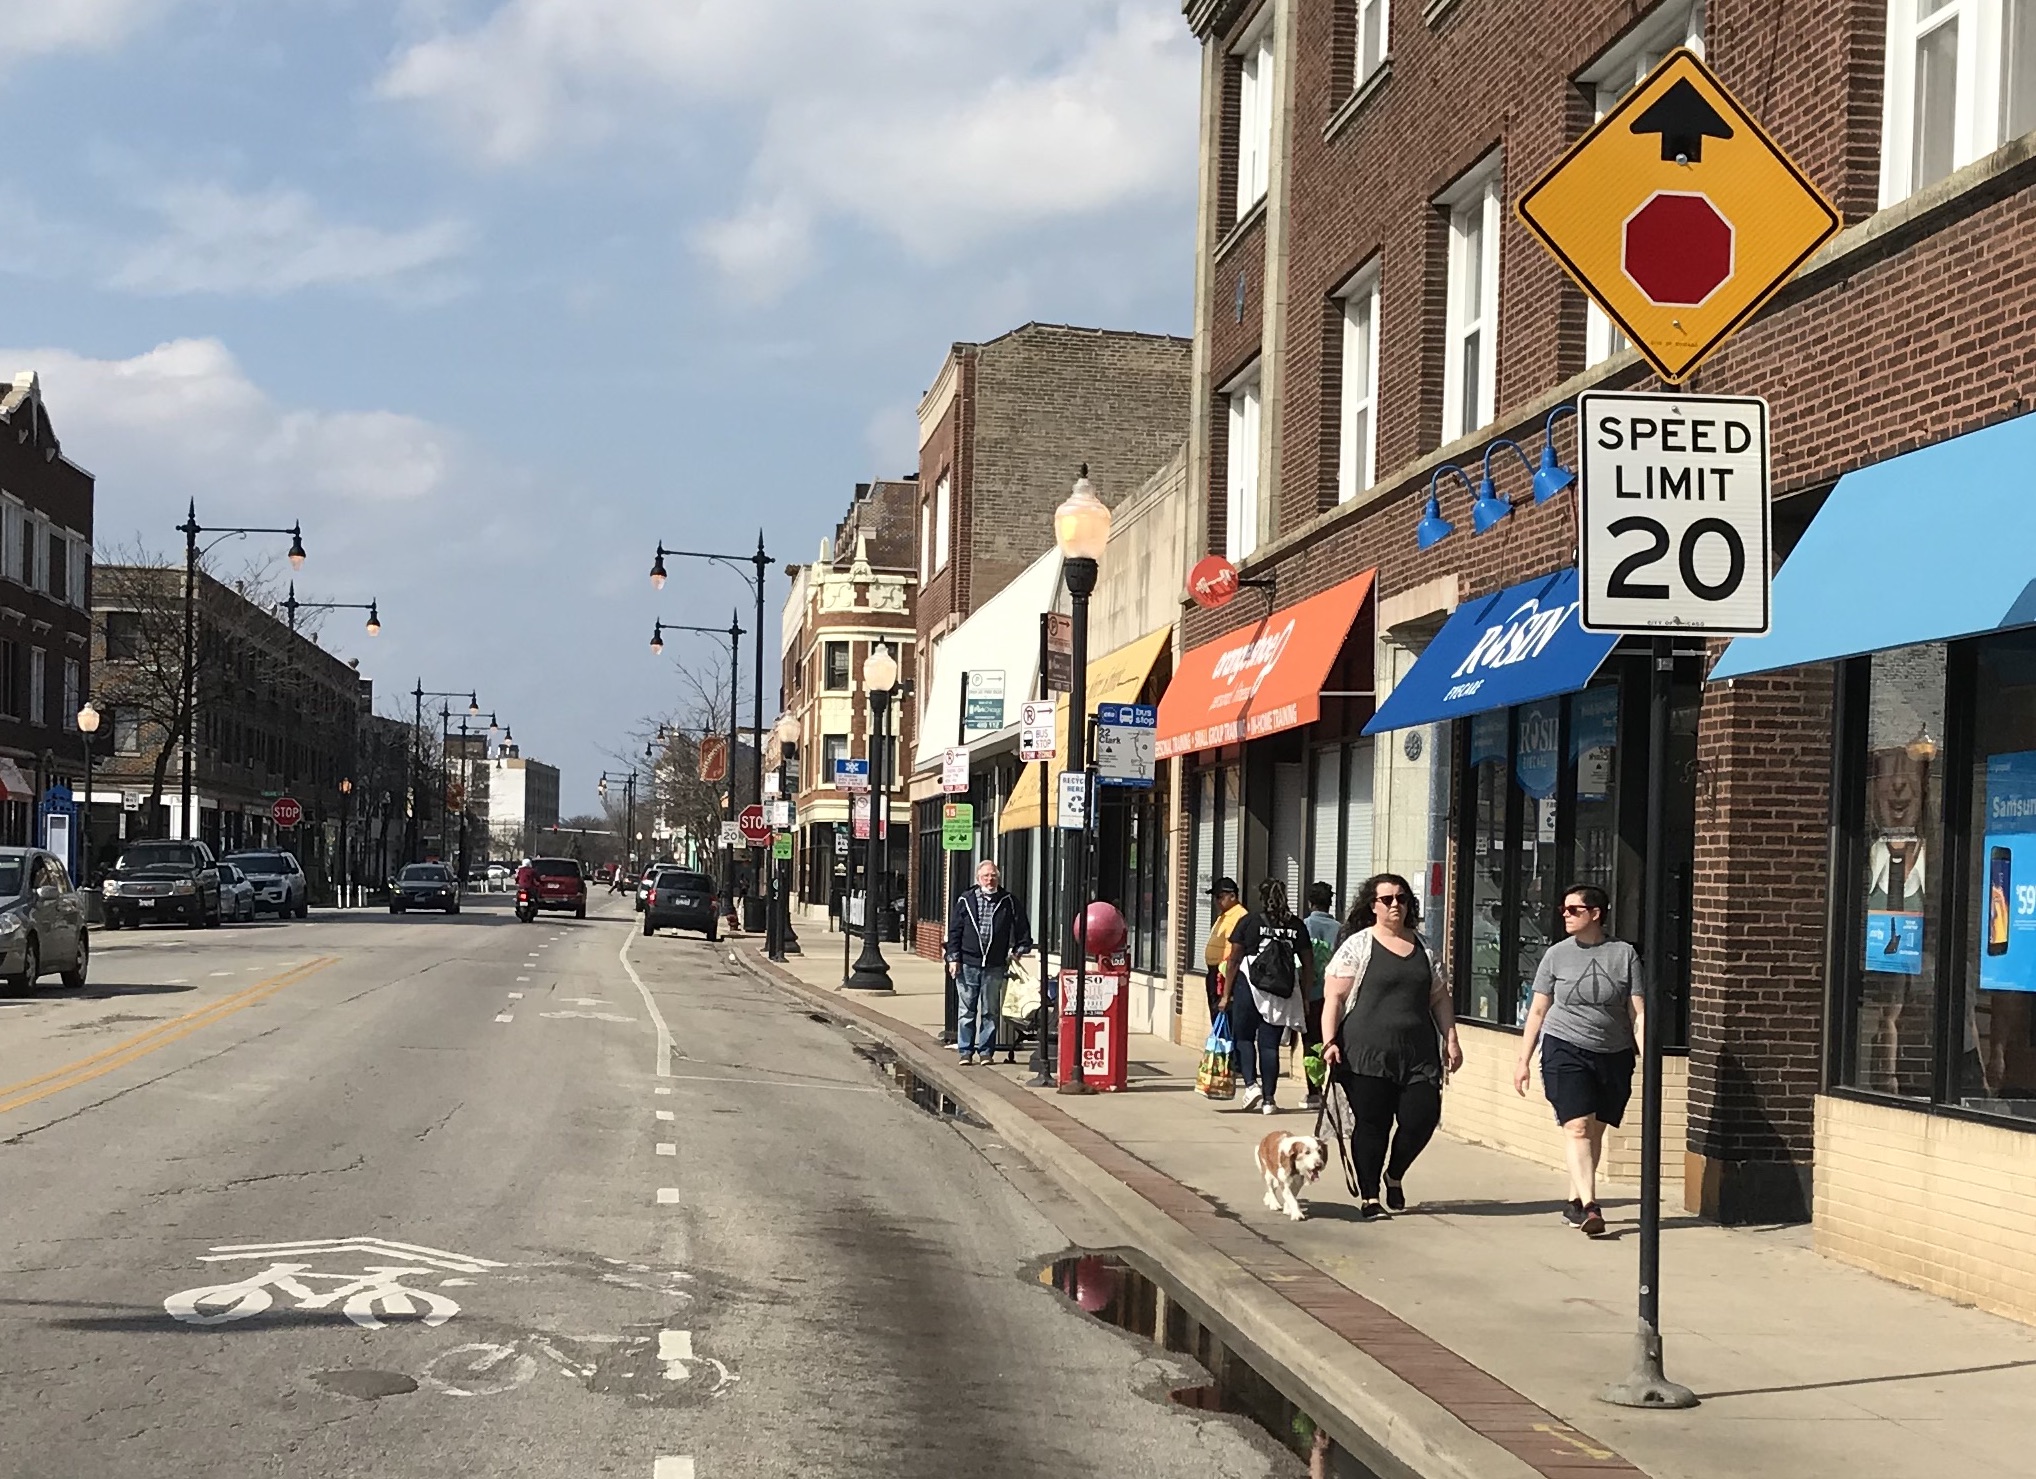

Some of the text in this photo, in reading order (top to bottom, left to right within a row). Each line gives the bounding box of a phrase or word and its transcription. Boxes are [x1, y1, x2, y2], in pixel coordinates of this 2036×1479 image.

[1598, 416, 1752, 454] SPEED
[1616, 464, 1734, 502] LIMIT
[1606, 515, 1746, 602] 20
[1451, 598, 1580, 679] ROSIN
[1135, 707, 1152, 717] bus
[1135, 717, 1155, 726] stop
[1035, 729, 1048, 738] BUS
[1099, 727, 1111, 737] 22
[1035, 738, 1052, 749] STOP
[1099, 736, 1121, 745] Clark
[1062, 776, 1084, 785] RECYC
[274, 806, 300, 818] STOP
[1992, 795, 2036, 819] Samsun
[741, 815, 767, 830] STO
[723, 831, 738, 841] 20
[1083, 1060, 1105, 1070] eye
